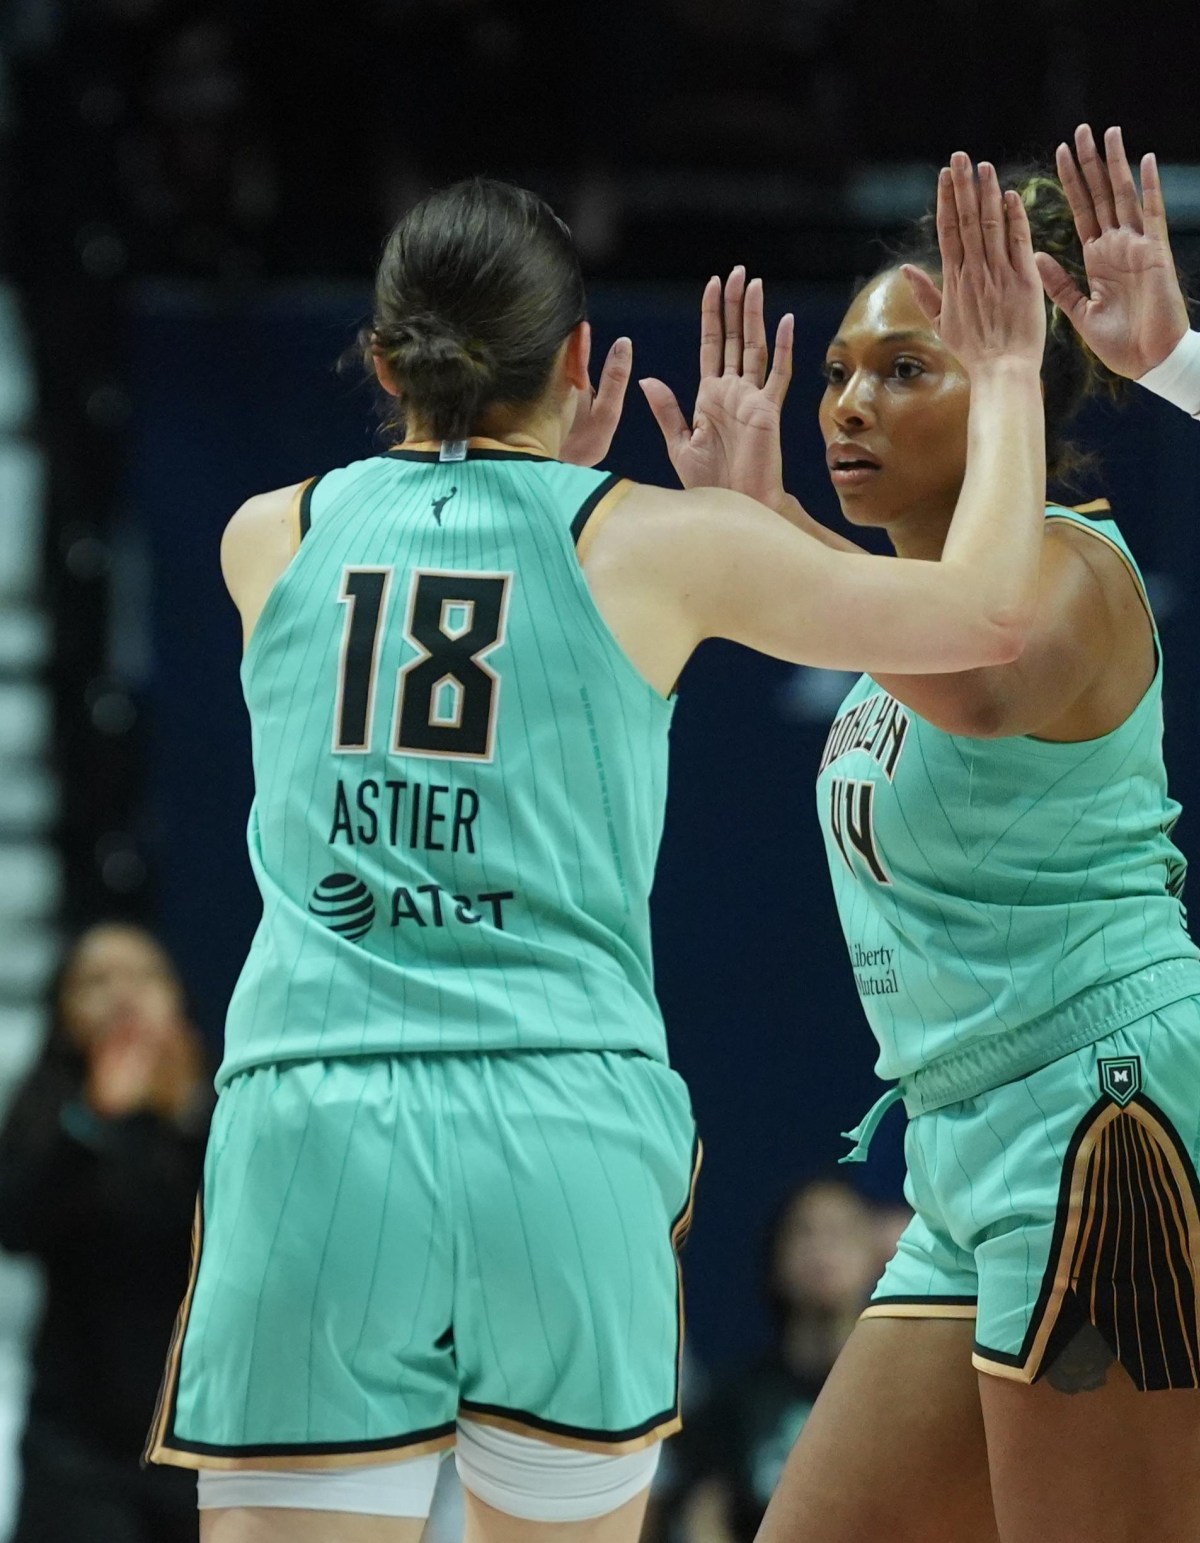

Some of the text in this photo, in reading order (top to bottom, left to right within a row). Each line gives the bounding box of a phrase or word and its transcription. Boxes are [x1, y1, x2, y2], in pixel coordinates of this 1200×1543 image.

[331, 566, 514, 763] 18
[328, 778, 480, 854] ASTIER
[390, 884, 514, 930] AT&T
[849, 944, 895, 975] Liberty
[1113, 1070, 1129, 1083] M
